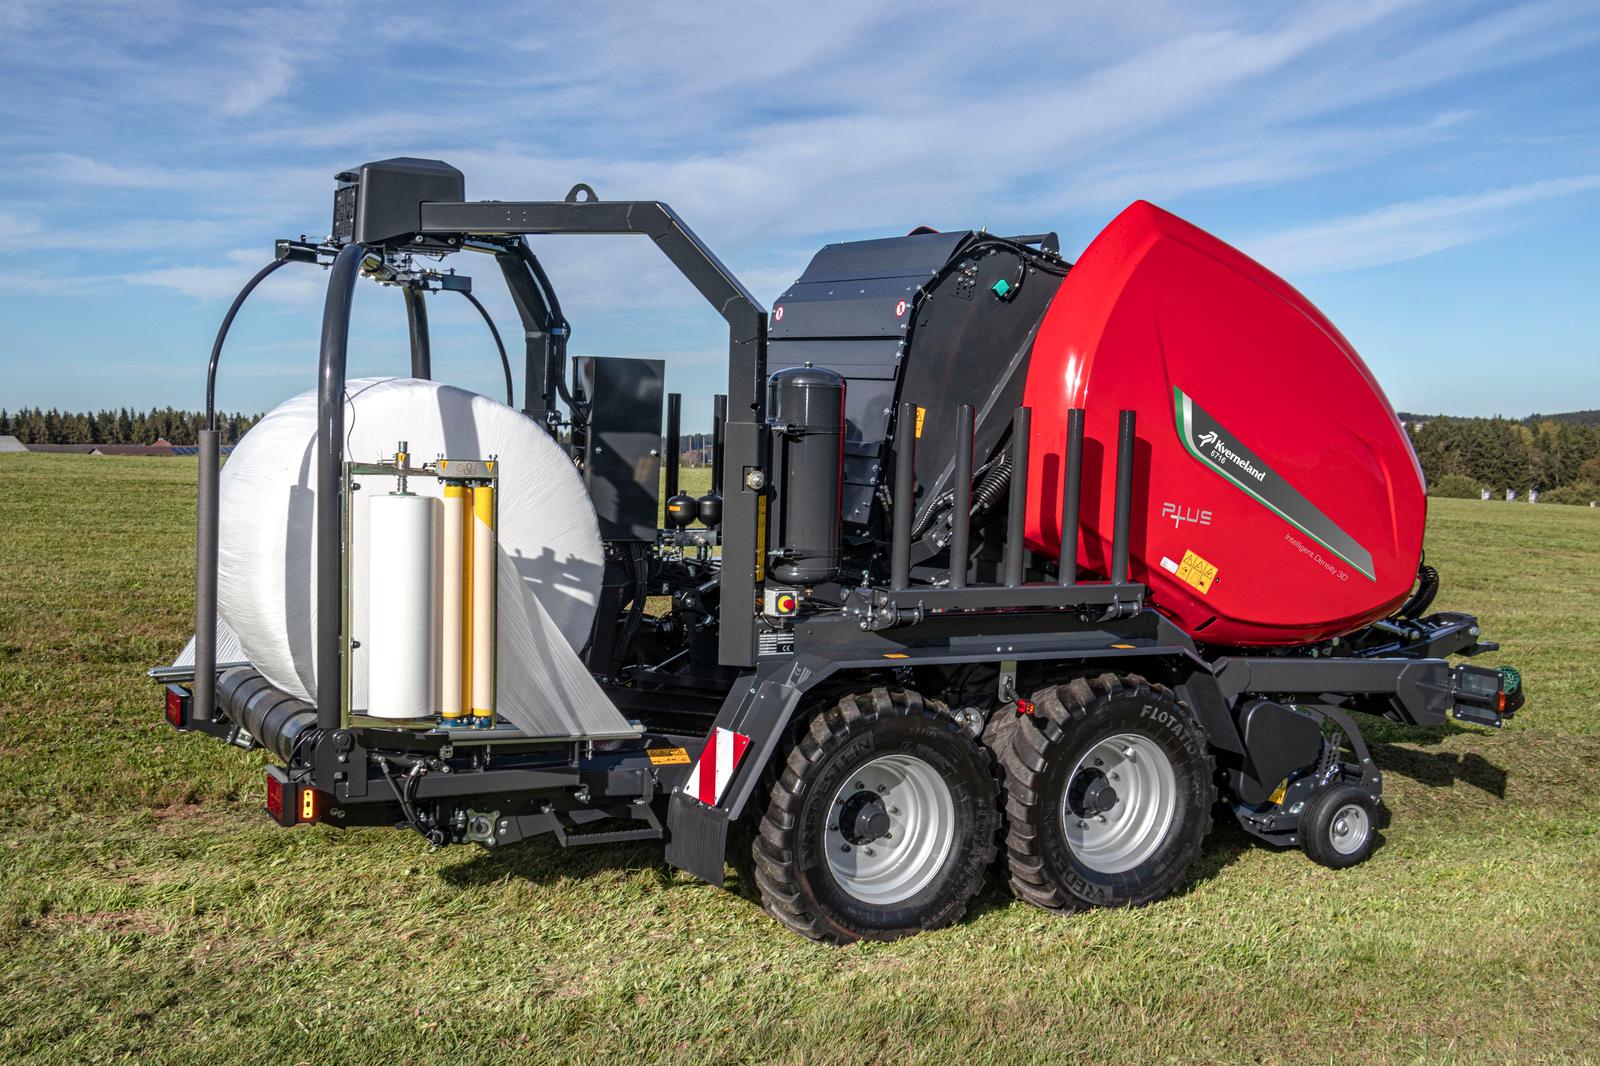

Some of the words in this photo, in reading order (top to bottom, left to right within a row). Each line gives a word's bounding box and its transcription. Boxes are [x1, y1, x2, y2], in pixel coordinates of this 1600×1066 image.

[1215, 439, 1266, 482] Kverneland
[1285, 533, 1315, 558] Intelligent
[1313, 554, 1337, 575] Density
[1336, 570, 1349, 582] 3D
